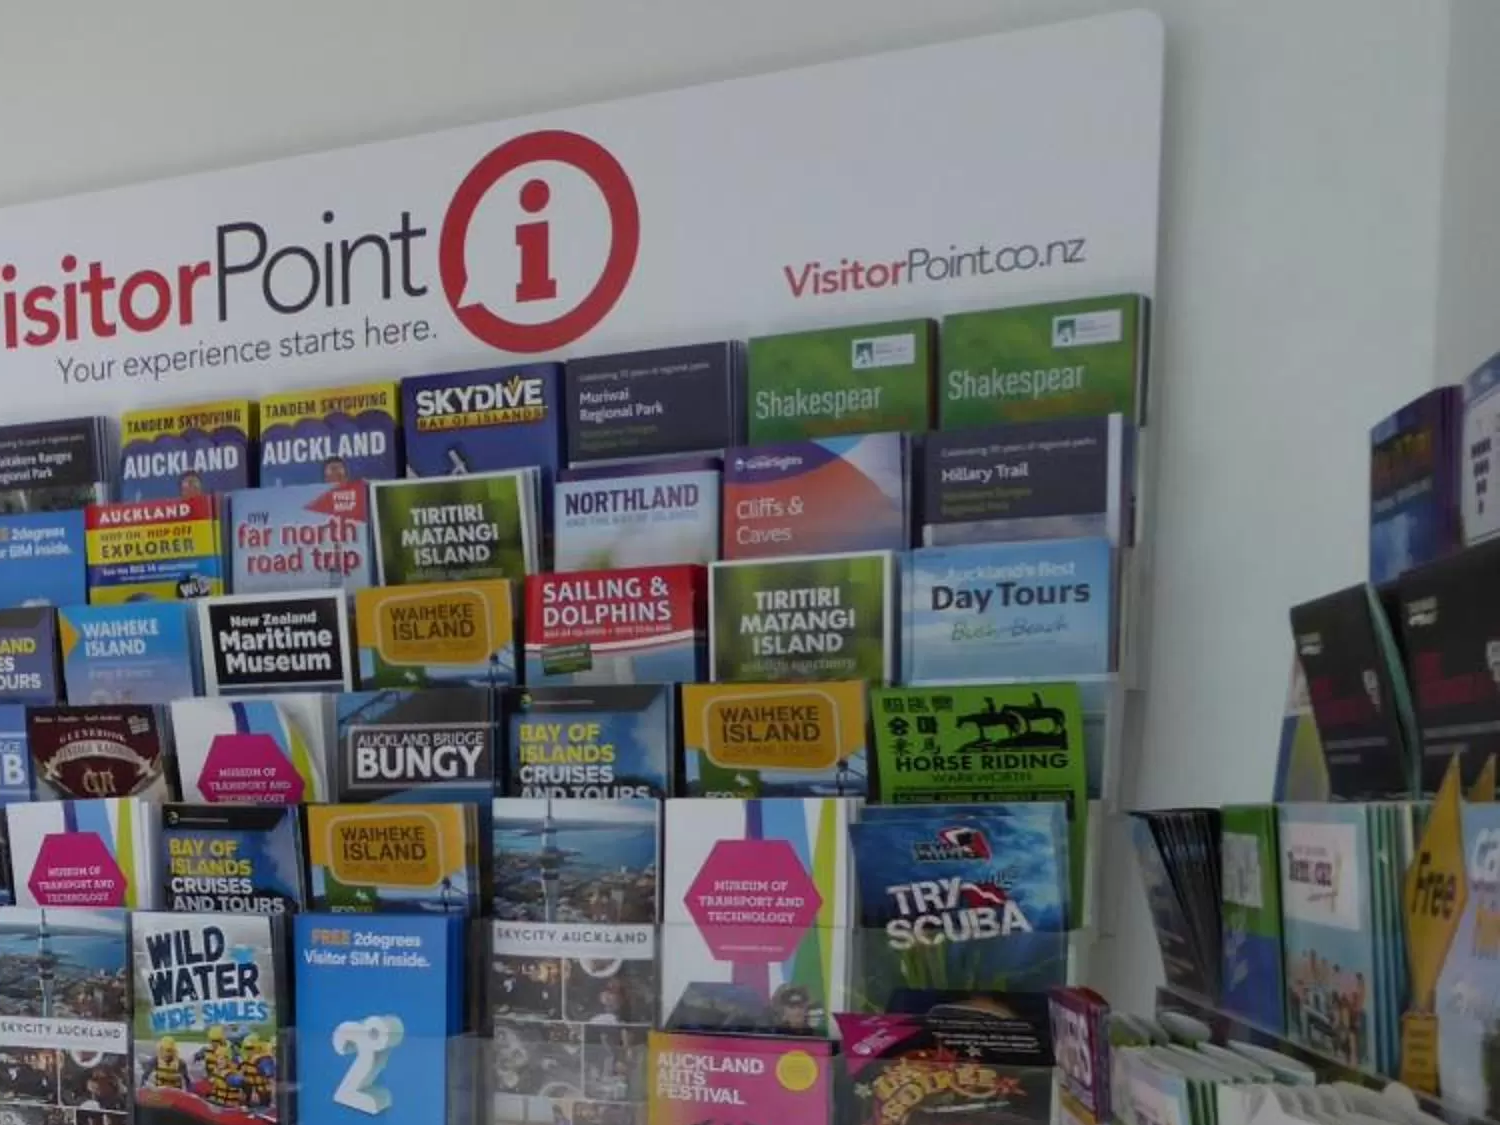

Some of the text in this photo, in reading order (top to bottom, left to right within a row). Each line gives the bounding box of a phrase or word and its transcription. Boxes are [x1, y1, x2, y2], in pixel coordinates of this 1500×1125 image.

[784, 237, 1087, 299] VisitorPoint.co.nz
[57, 314, 438, 386] Your experience starts here.
[948, 362, 1085, 400] Shakespear
[266, 391, 388, 419] TANDEM SKYDIVING
[416, 376, 543, 416] SKYDIVE
[579, 387, 629, 405] Muriwai
[755, 386, 882, 421] Shakespear
[127, 408, 242, 434] TANDEM SKYDIVING
[579, 400, 664, 424] Regional Park
[263, 431, 386, 466] AUCKLAND
[32, 465, 53, 480] Park
[124, 445, 239, 479] AUCKLAND
[941, 462, 1029, 484] Hillary Trail
[564, 483, 700, 516] NORTHLAND
[736, 496, 805, 520] Cliffs &
[99, 503, 192, 525] AUCKLAND
[247, 511, 270, 526] my
[410, 504, 484, 526] TIRITIRI
[237, 515, 358, 549] far north
[401, 521, 499, 546] MATANGI
[736, 525, 793, 545] Caves
[101, 538, 195, 559] EXPLORER
[246, 543, 362, 577] road trip
[413, 545, 491, 568] ISLAND
[543, 575, 669, 604] SAILING &
[754, 586, 841, 611] TIRITIRI
[931, 582, 1091, 614] Day Tours
[229, 610, 317, 628] New Zealand
[389, 602, 475, 622] WAIHEKE
[543, 599, 672, 628] DOLPHINS
[740, 608, 856, 633] MATANGI
[81, 618, 159, 638] WAIHEKE
[219, 626, 333, 653] Maritime
[392, 619, 476, 641] ISLAND
[85, 638, 147, 657] ISLAND
[752, 633, 844, 656] ISLAND
[226, 651, 333, 675] Museum
[719, 705, 820, 724] WAIHEKE
[357, 729, 485, 747] AUCKLAND BRIDGE
[520, 723, 601, 743] BAY OF
[721, 722, 821, 744] ISLAND
[356, 746, 483, 780] BUNGY
[519, 744, 616, 764] ISLANDS
[895, 752, 1069, 773] HORSE RIDING
[519, 764, 614, 784] CRUISES
[340, 826, 426, 843] WAIHEKE
[169, 838, 238, 857] BAY OF
[343, 843, 427, 862] ISLAND
[171, 859, 253, 877] ISLANDS
[171, 877, 253, 895] CRUISES
[714, 879, 789, 894] MUSEUM OF
[886, 876, 962, 916] TRY
[1412, 851, 1458, 921] Free
[173, 896, 285, 913] AND TOURS
[697, 895, 806, 909] TRANSPORT AND
[707, 911, 797, 925] TECHNOLOGY
[886, 902, 1034, 951] SCUBA
[311, 928, 421, 951] FREE 2degrees
[496, 927, 649, 945] SKYCITY AUCKLAND
[146, 925, 225, 971] WILD
[303, 950, 431, 969] Visitor SIM inside.
[148, 961, 261, 1007] WATER
[150, 1000, 270, 1033] WIDE SMILES
[55, 1024, 122, 1039] AUCKLAND
[657, 1050, 765, 1074] AUCKLAND
[656, 1067, 707, 1088] ARTS
[657, 1084, 747, 1107] FESTIVAL
